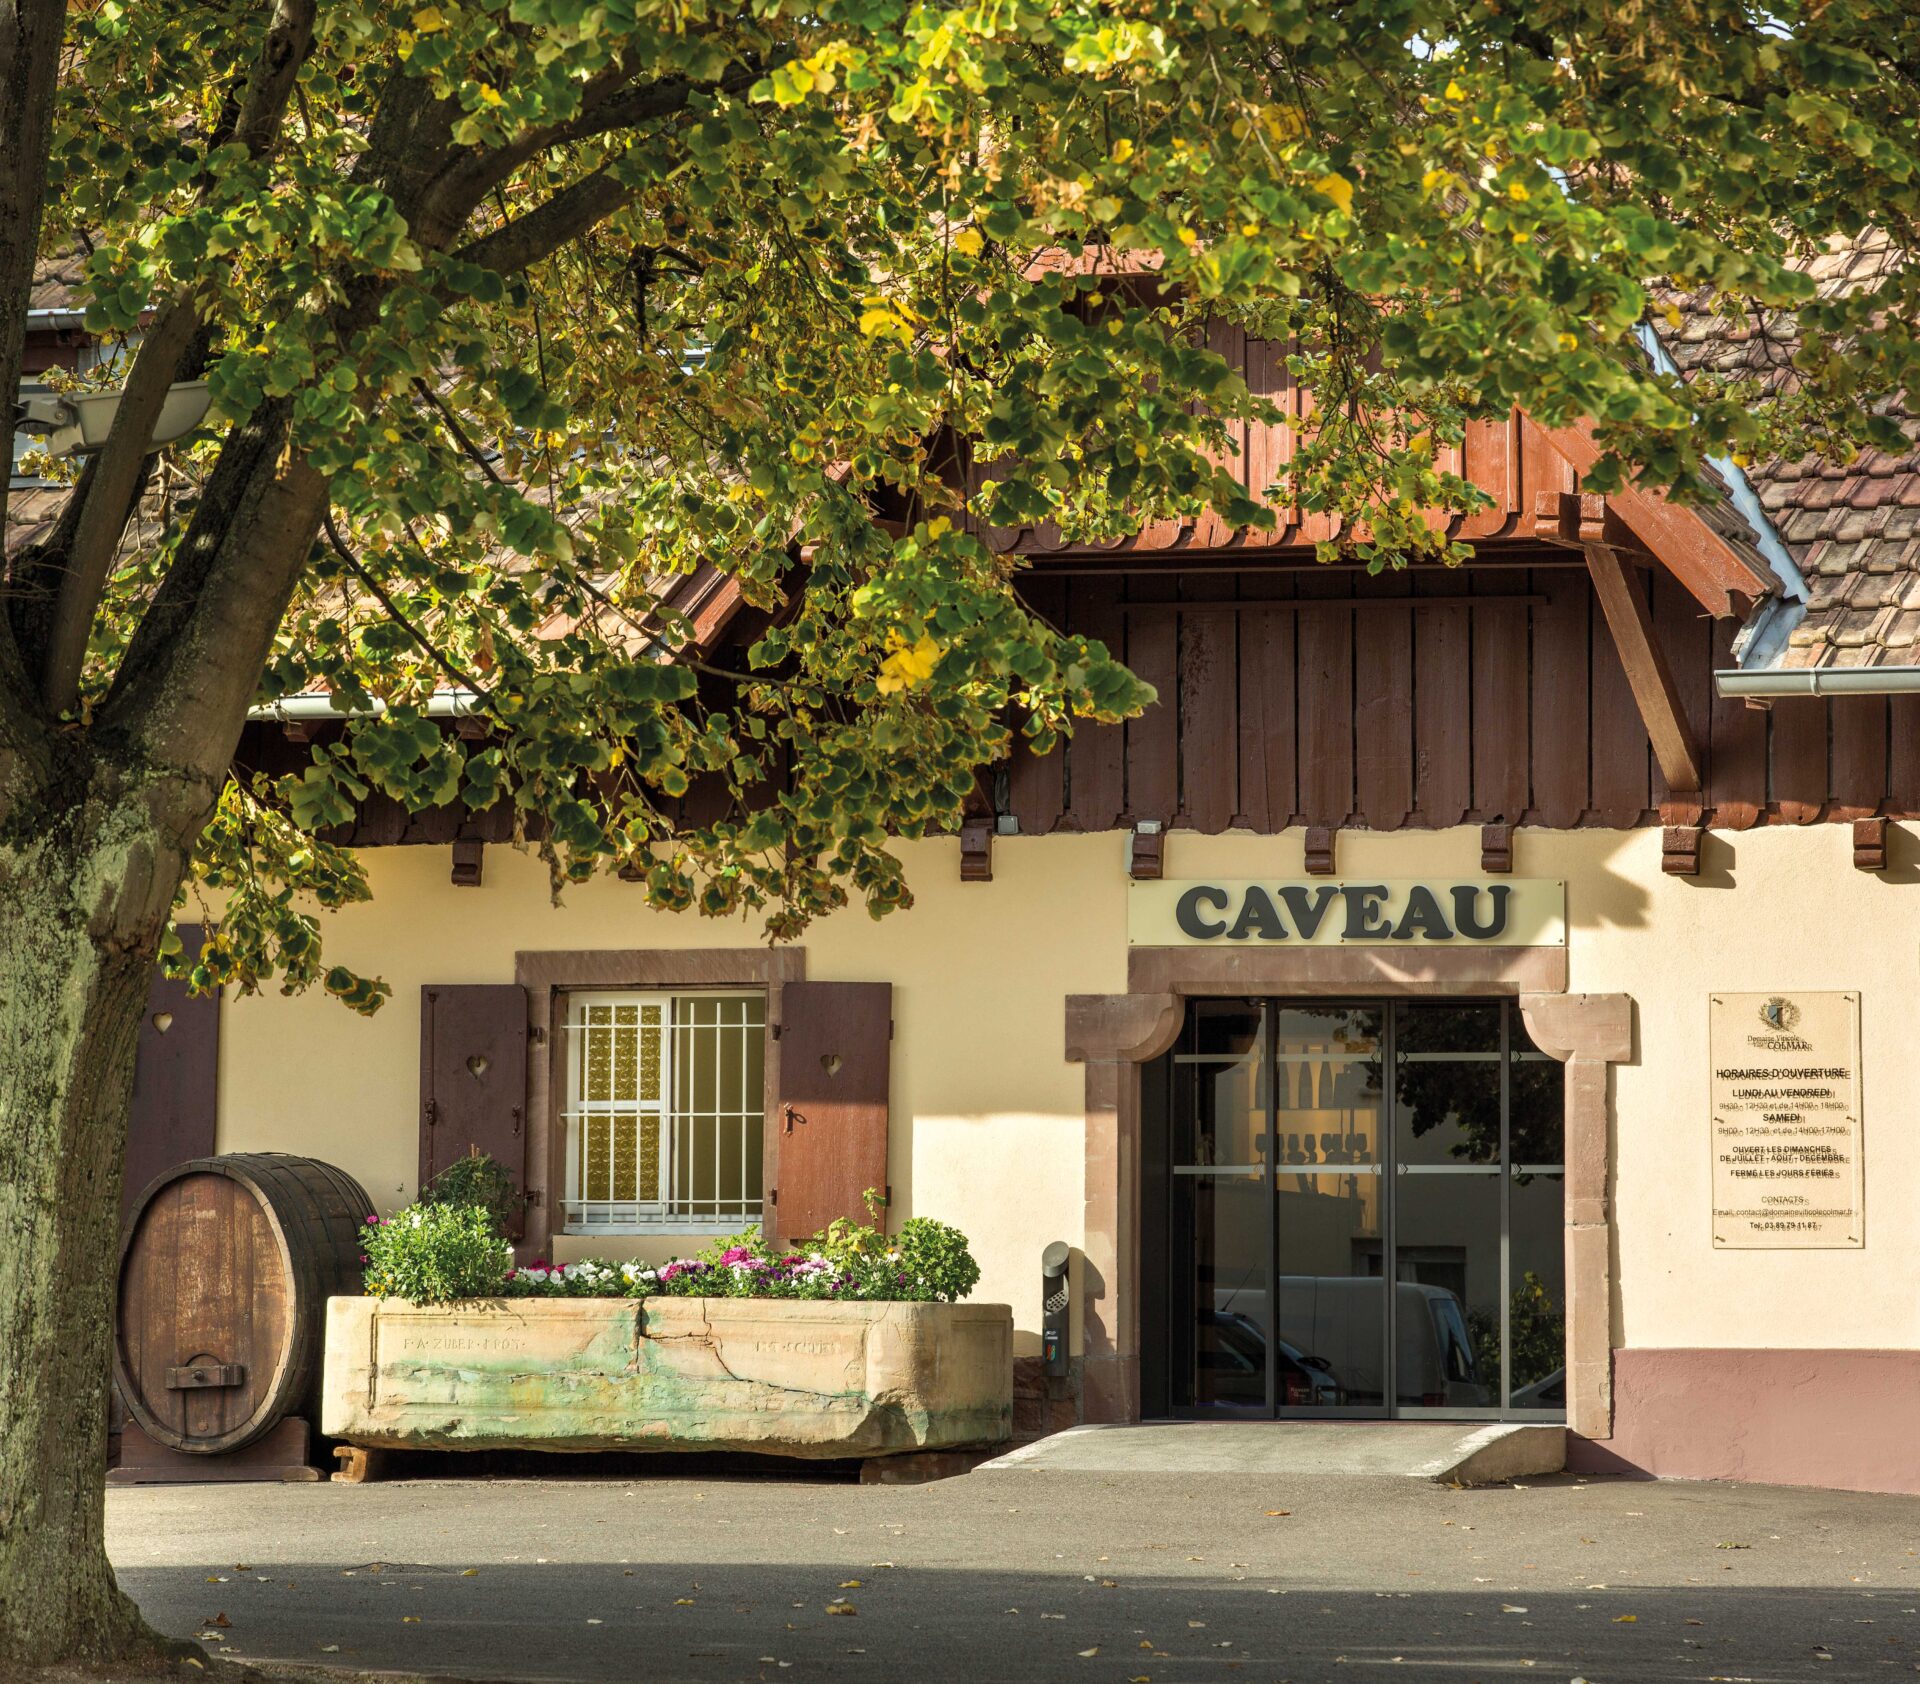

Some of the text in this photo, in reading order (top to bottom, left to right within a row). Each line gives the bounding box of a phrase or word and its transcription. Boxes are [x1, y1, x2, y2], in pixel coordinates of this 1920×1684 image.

[1176, 885, 1511, 940] CAVEAU
[1767, 1042, 1808, 1050] COLMAR
[1716, 1068, 1846, 1078] HORAIRES D'OUVERTURE
[1732, 1088, 1830, 1097] LUNDI AU VENDREDI
[1762, 1113, 1800, 1122] SAMEDI
[1784, 1145, 1832, 1153] DIMANCHES
[1759, 1169, 1775, 1177] LES
[1776, 1169, 1804, 1177] JOURS
[1761, 1196, 1804, 1204] CONTACTS
